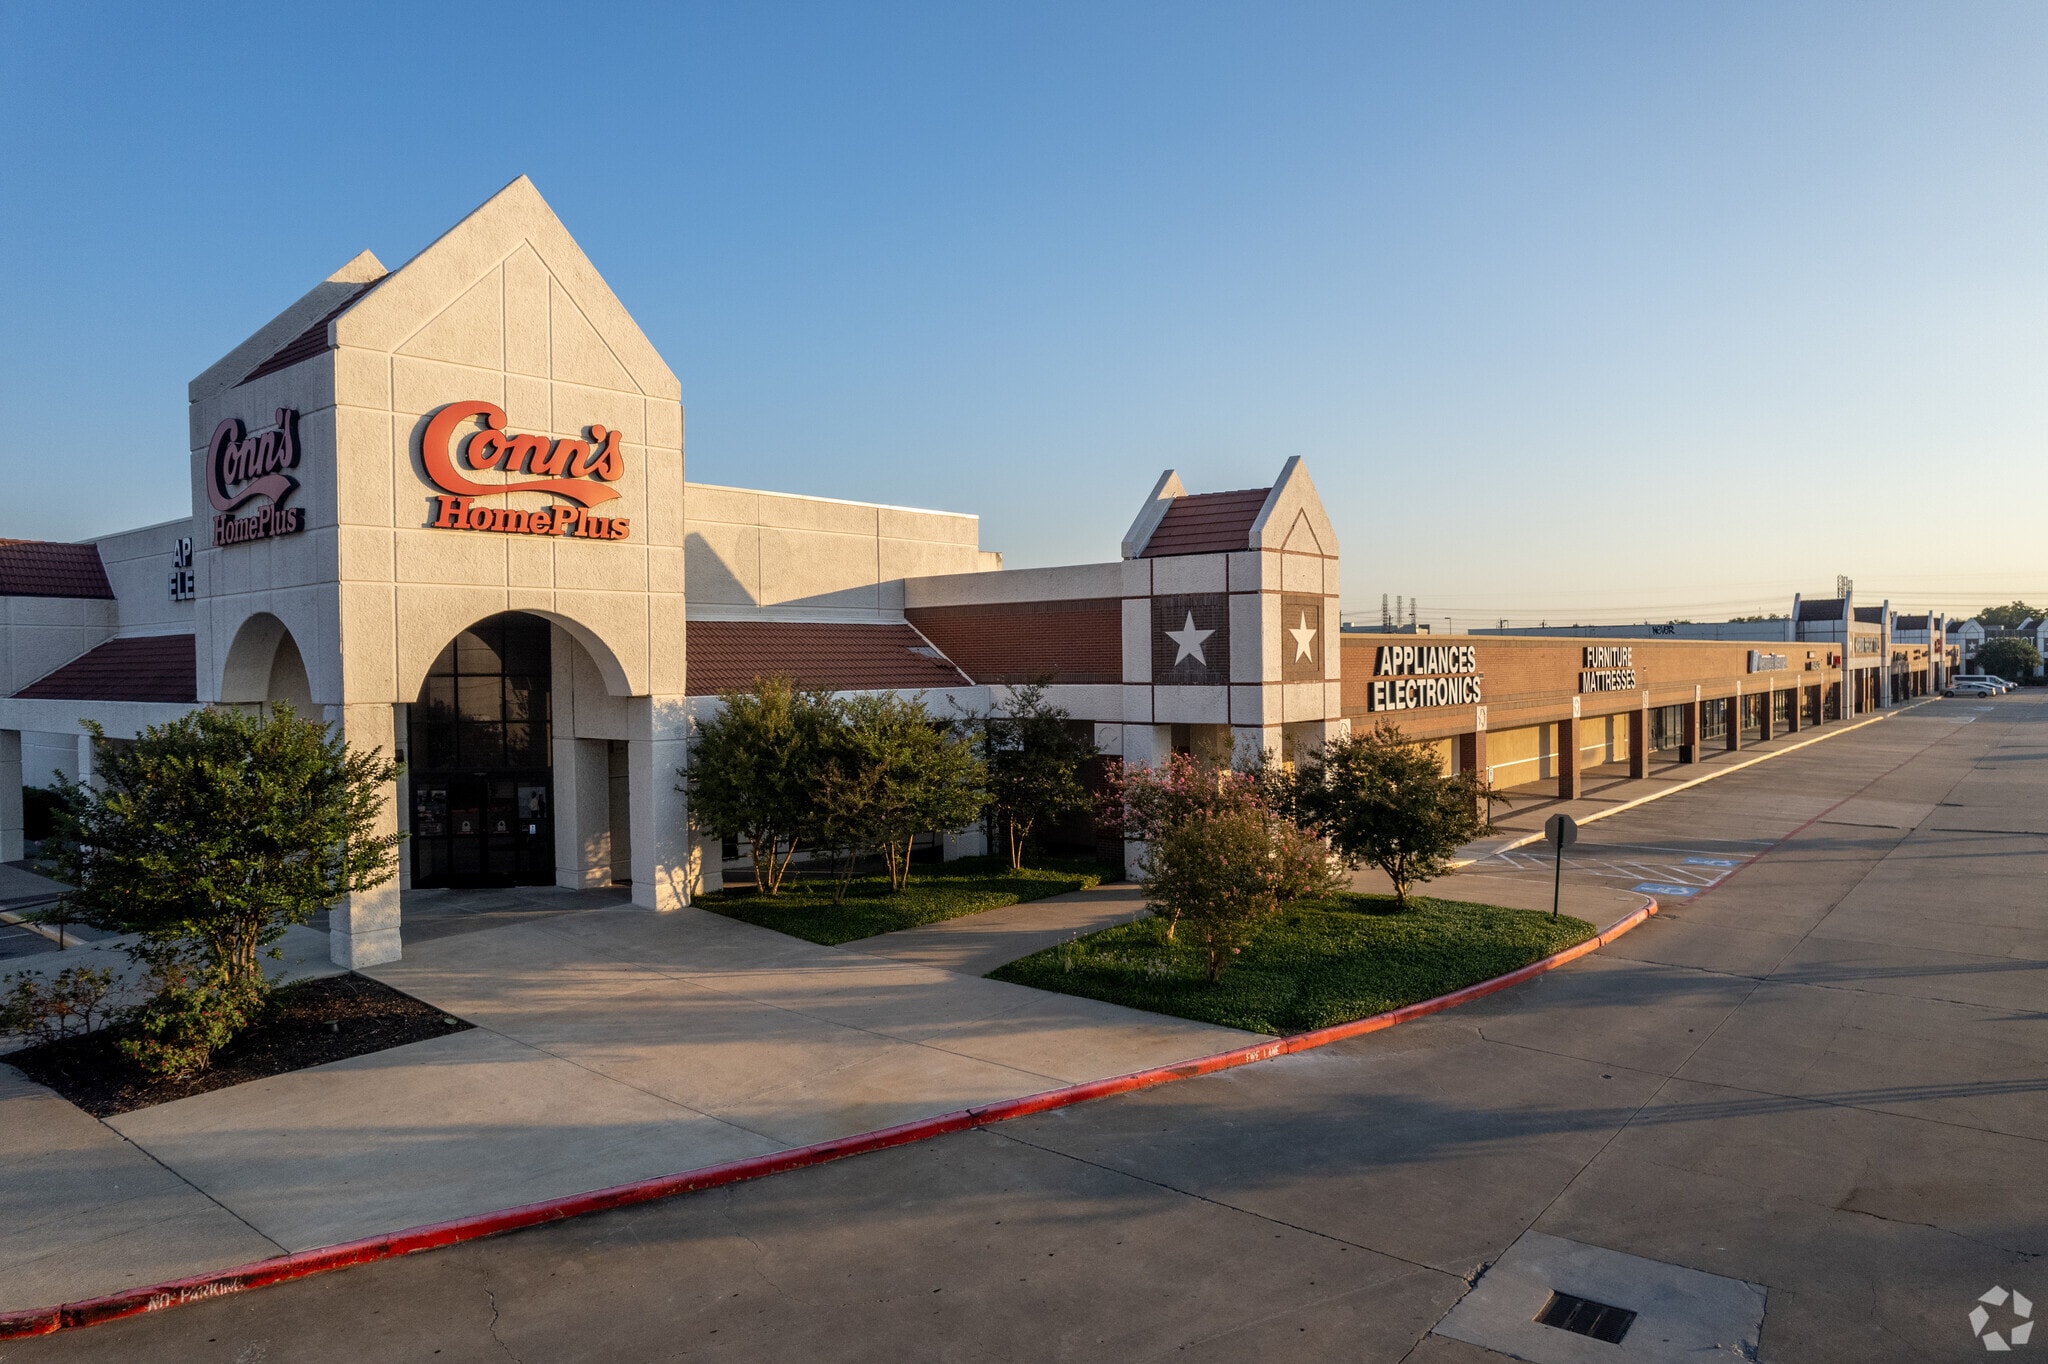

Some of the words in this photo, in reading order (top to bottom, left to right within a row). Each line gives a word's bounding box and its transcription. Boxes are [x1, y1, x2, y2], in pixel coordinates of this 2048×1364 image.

[206, 407, 294, 511] Conn's
[423, 401, 624, 508] Conn's
[213, 504, 297, 546] HomePlus
[435, 495, 630, 540] HomePlus
[1379, 645, 1476, 676] APPLIANCES
[1586, 646, 1633, 668] FURNITURE
[1373, 676, 1481, 712] ELECTRONICS
[1582, 669, 1636, 693] MATTRESSES
